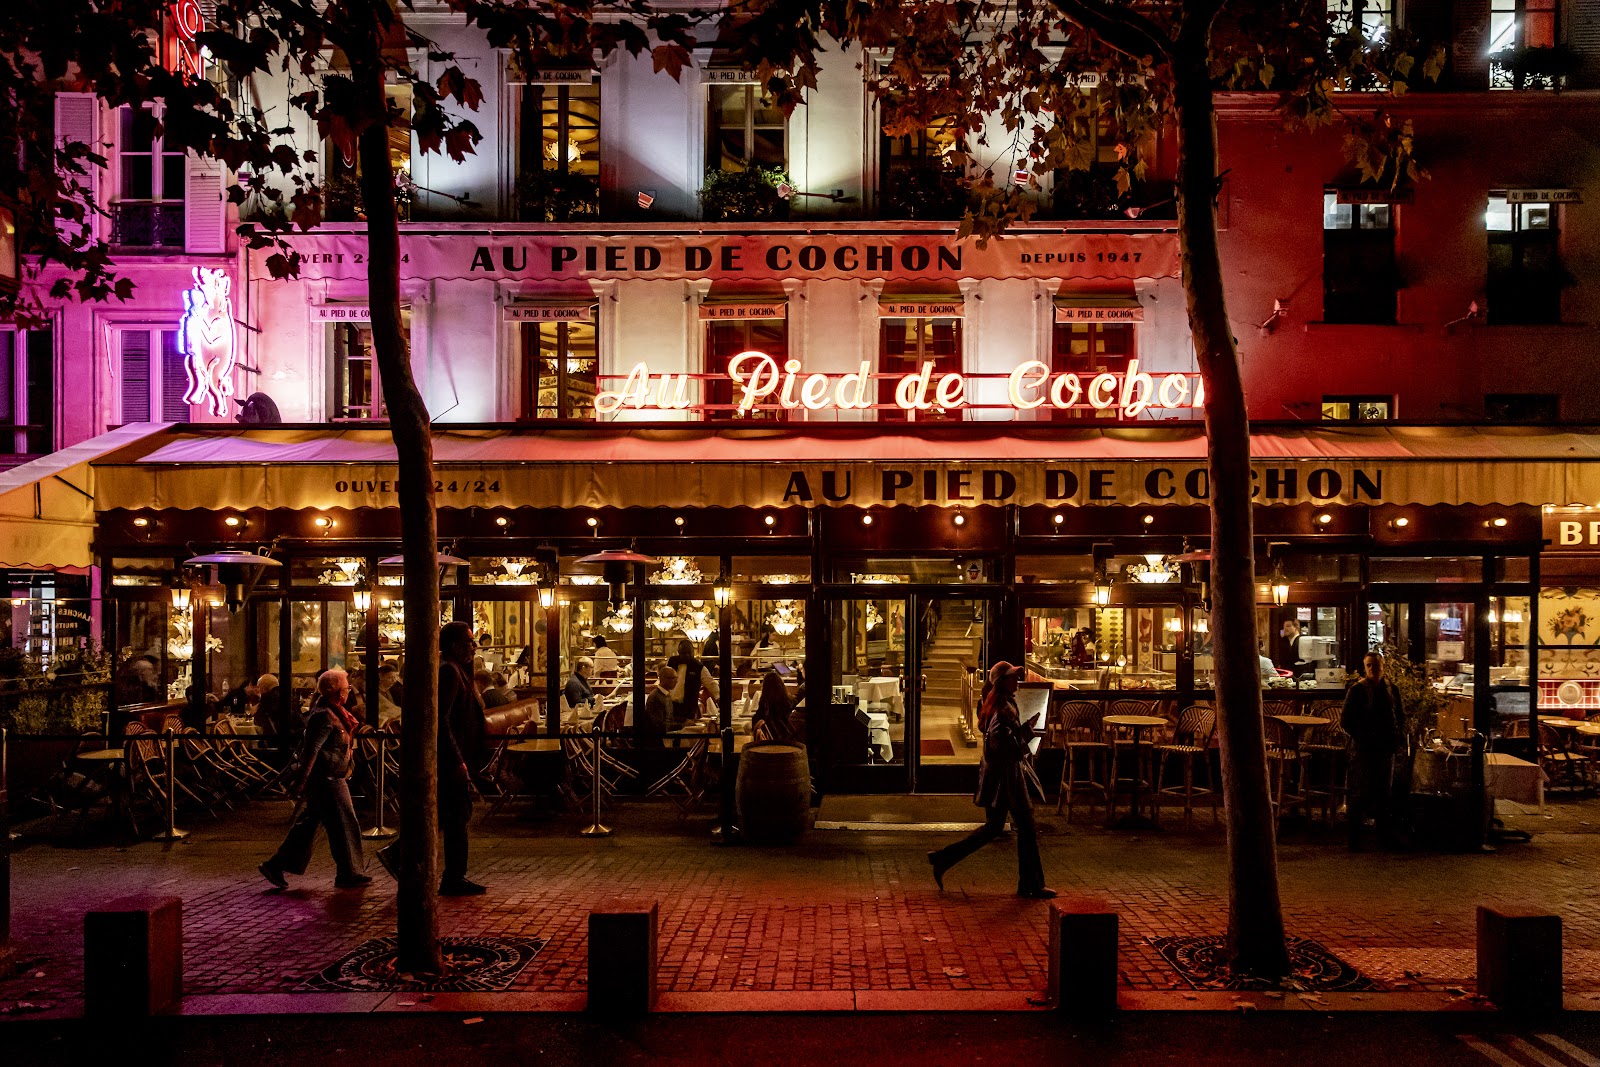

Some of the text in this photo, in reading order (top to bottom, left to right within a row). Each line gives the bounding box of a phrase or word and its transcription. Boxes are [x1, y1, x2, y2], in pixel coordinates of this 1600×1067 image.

[545, 71, 552, 80] DE
[555, 71, 582, 80] COCHON
[709, 71, 717, 80] AU
[720, 71, 735, 80] PIED
[1523, 191, 1538, 200] PIED
[300, 253, 345, 264] VERT
[469, 245, 963, 272] AU PIED DE COCHON
[1021, 251, 1143, 264] DEPUIS 1947
[319, 309, 327, 318] AU
[330, 309, 346, 318] PIED
[349, 309, 358, 318] DE
[512, 308, 580, 318] AU PIED DE COCHON
[708, 306, 776, 317] AU PIED DE COCHON
[888, 305, 956, 313] AU PIED DE COCHON
[1066, 310, 1134, 319] AU PIED DE COCHON
[594, 360, 691, 413] Au
[727, 350, 873, 410] Pied
[895, 360, 966, 411] de
[335, 480, 501, 493] OUVE 24/24
[782, 467, 1383, 502] AU PIED DE COHON
